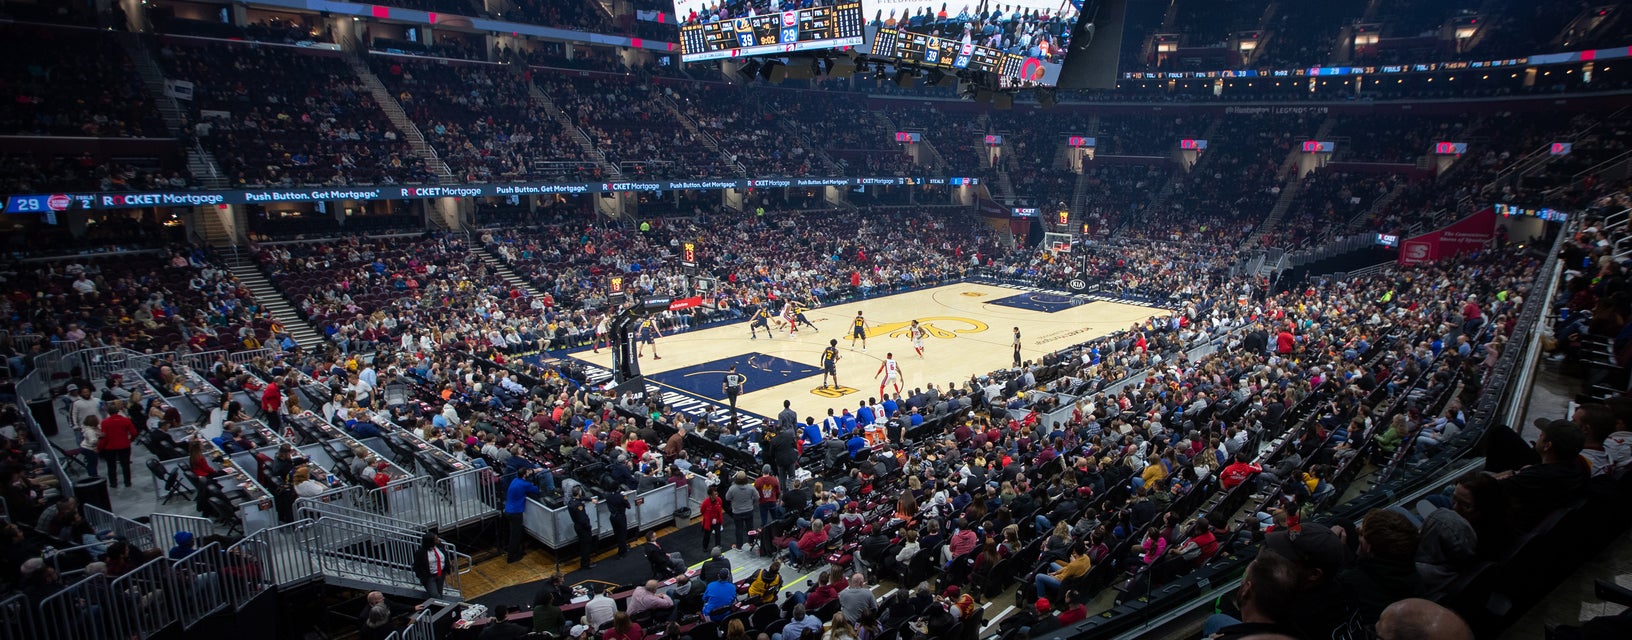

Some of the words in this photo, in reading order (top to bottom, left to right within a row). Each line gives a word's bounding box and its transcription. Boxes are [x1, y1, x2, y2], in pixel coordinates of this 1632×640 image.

[753, 19, 760, 27] 20
[784, 29, 796, 42] 29
[740, 34, 754, 47] 39
[760, 36, 776, 45] 9:02
[927, 50, 938, 62] 39
[957, 56, 966, 66] 29
[496, 186, 514, 194] Push
[631, 183, 660, 191] Mortgage
[245, 192, 272, 201] Push
[272, 192, 310, 200] Button.
[312, 191, 330, 199] Get
[401, 188, 440, 196] ROCKET
[442, 188, 482, 196] Mortgage
[82, 200, 91, 208] 2
[102, 194, 161, 206] ROCKET
[162, 194, 224, 205] Mortgage
[17, 198, 40, 212] 29
[686, 251, 694, 262] 13
[1072, 281, 1084, 289] KIA
[826, 352, 832, 360] 2
